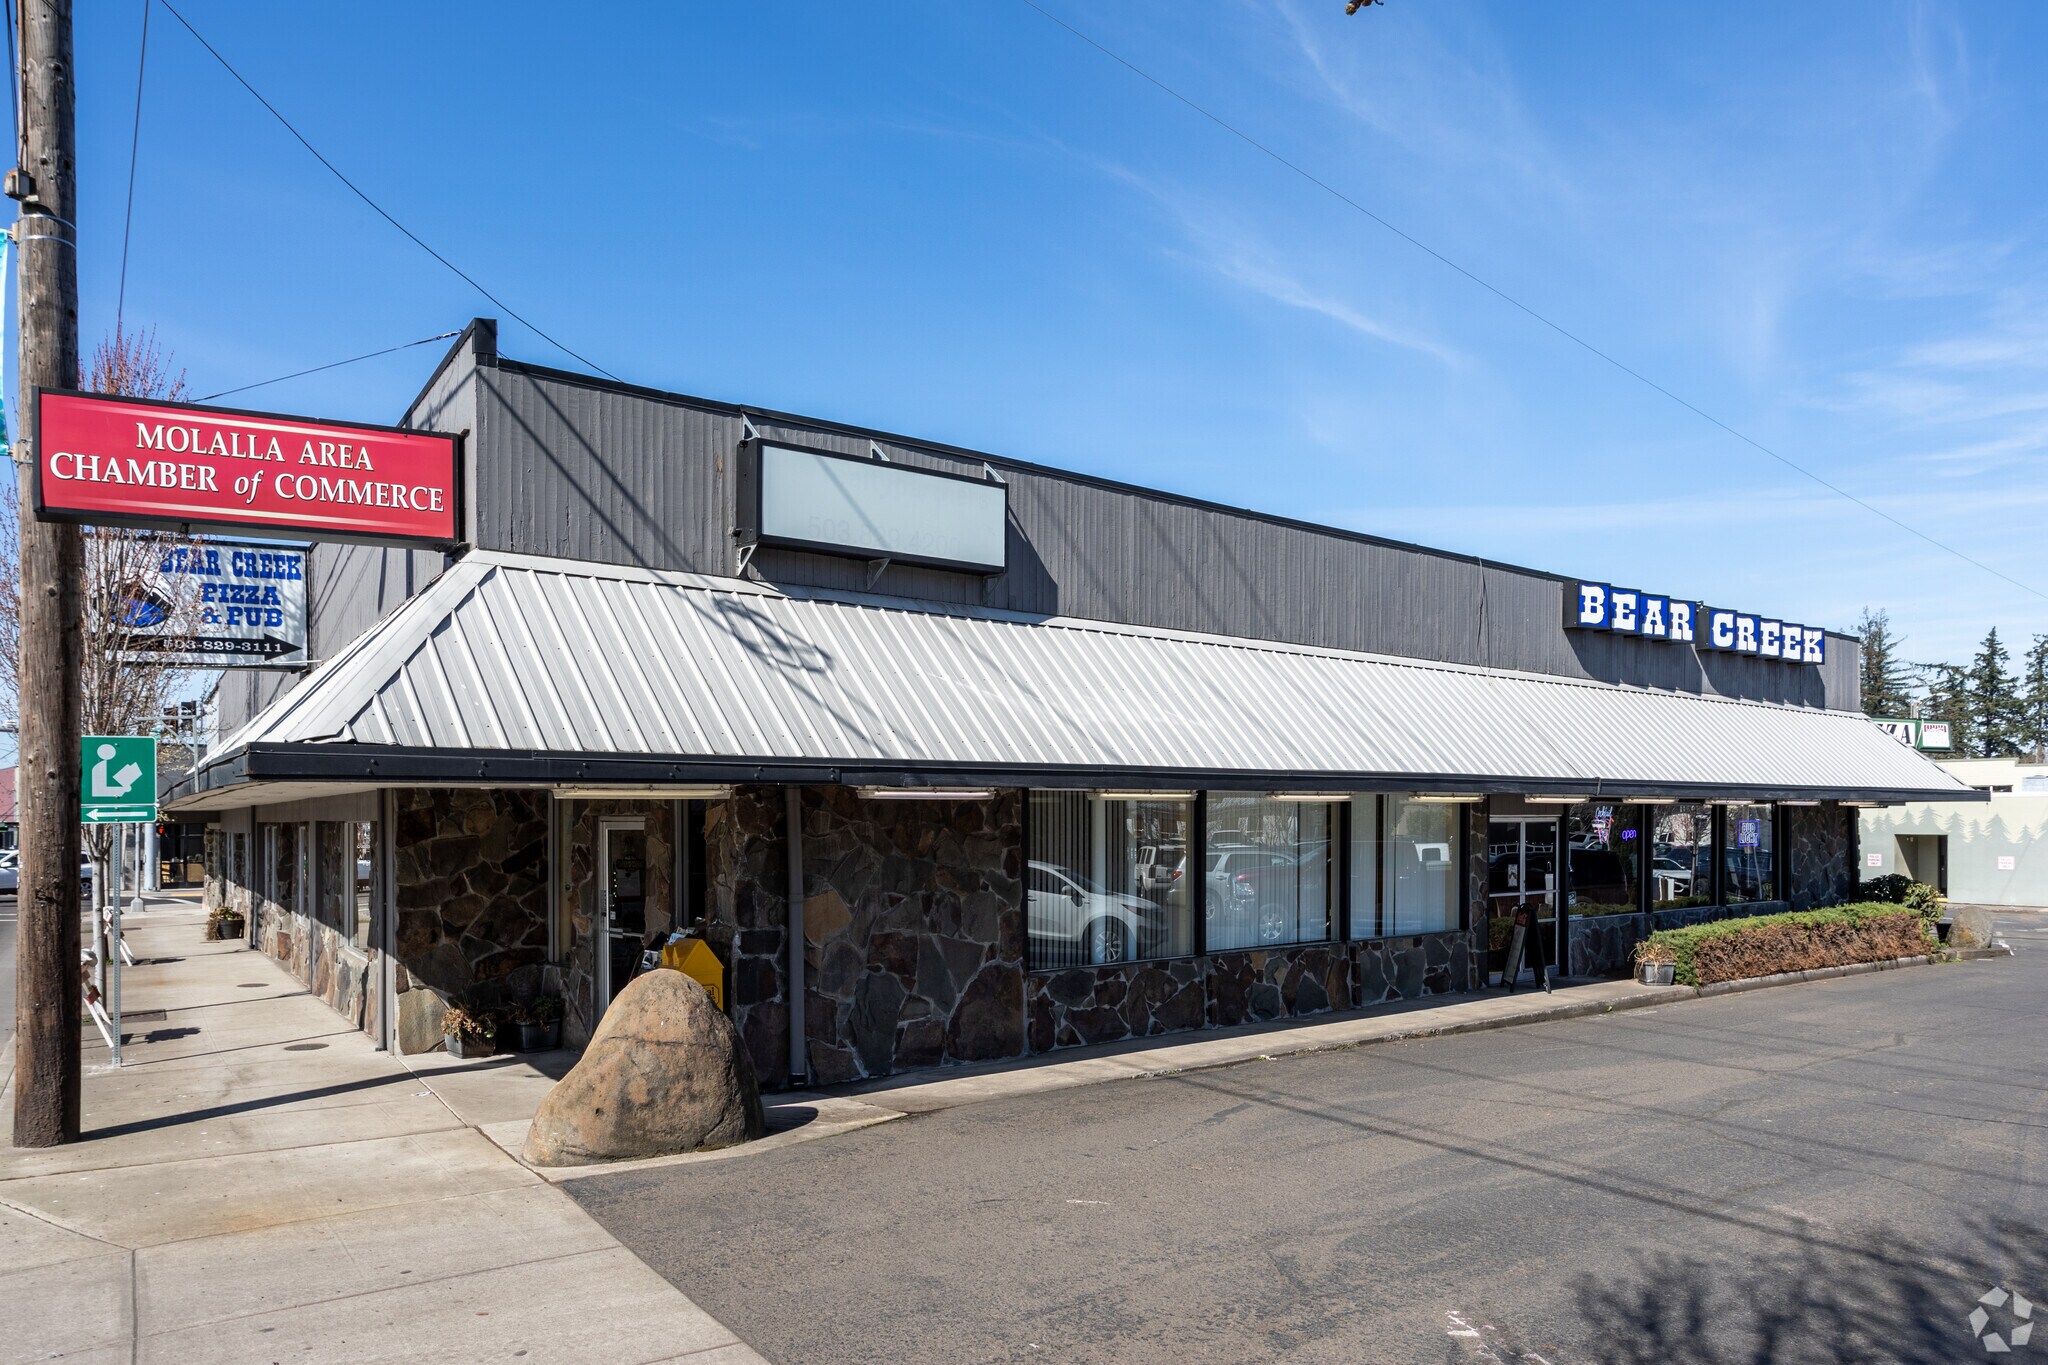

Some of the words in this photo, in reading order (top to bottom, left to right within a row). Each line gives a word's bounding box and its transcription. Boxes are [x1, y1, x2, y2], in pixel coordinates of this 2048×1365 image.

[136, 422, 285, 462] MOLALLA
[298, 440, 374, 471] AREA
[49, 452, 219, 492] CHAMBER
[234, 470, 264, 503] of
[274, 473, 445, 512] COMMERCE
[160, 548, 221, 576] BEAR
[232, 551, 301, 580] CREEK
[201, 583, 281, 605] PIZZA
[201, 607, 222, 625] &
[227, 606, 283, 627] PUB
[1580, 584, 1694, 641] BEAR
[1712, 612, 1823, 663] CREEK
